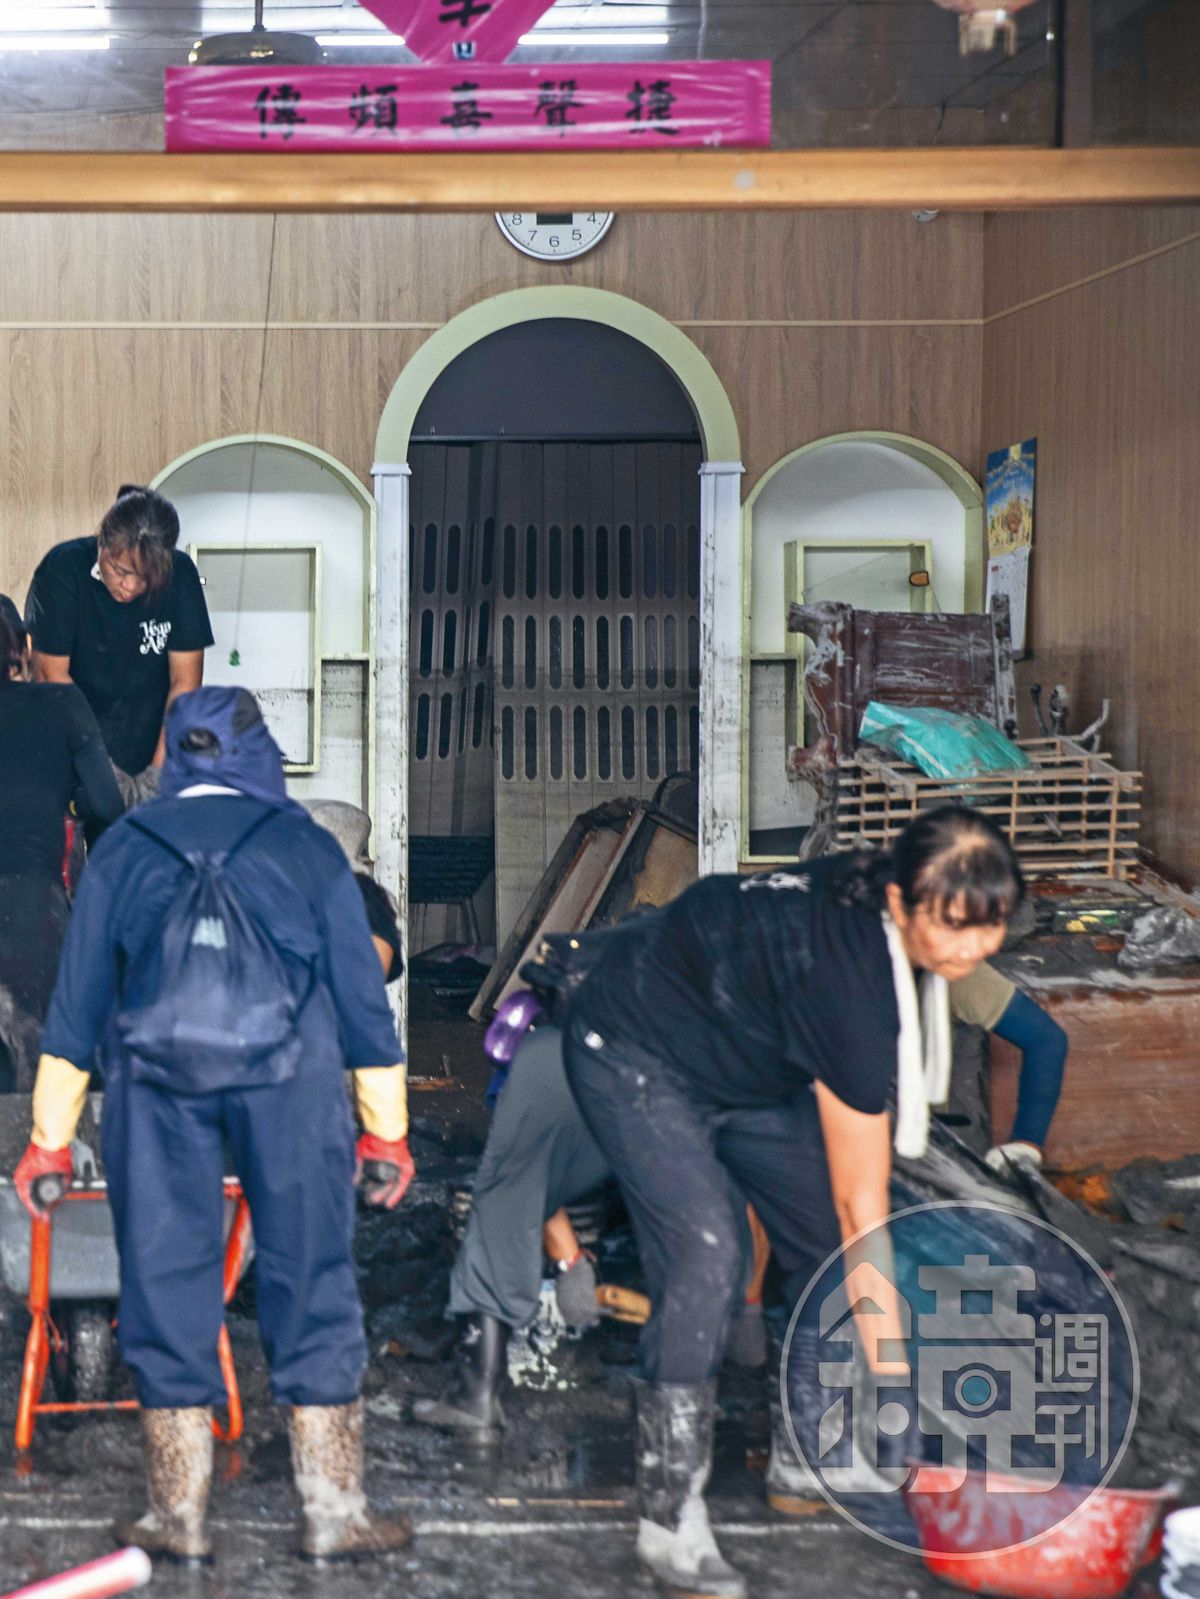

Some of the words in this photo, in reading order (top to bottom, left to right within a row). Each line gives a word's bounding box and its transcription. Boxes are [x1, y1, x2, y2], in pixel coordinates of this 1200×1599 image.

[511, 212, 523, 226] 8
[586, 212, 596, 224] 4
[528, 230, 538, 242] 7
[571, 229, 582, 241] 5
[548, 235, 560, 248] 6
